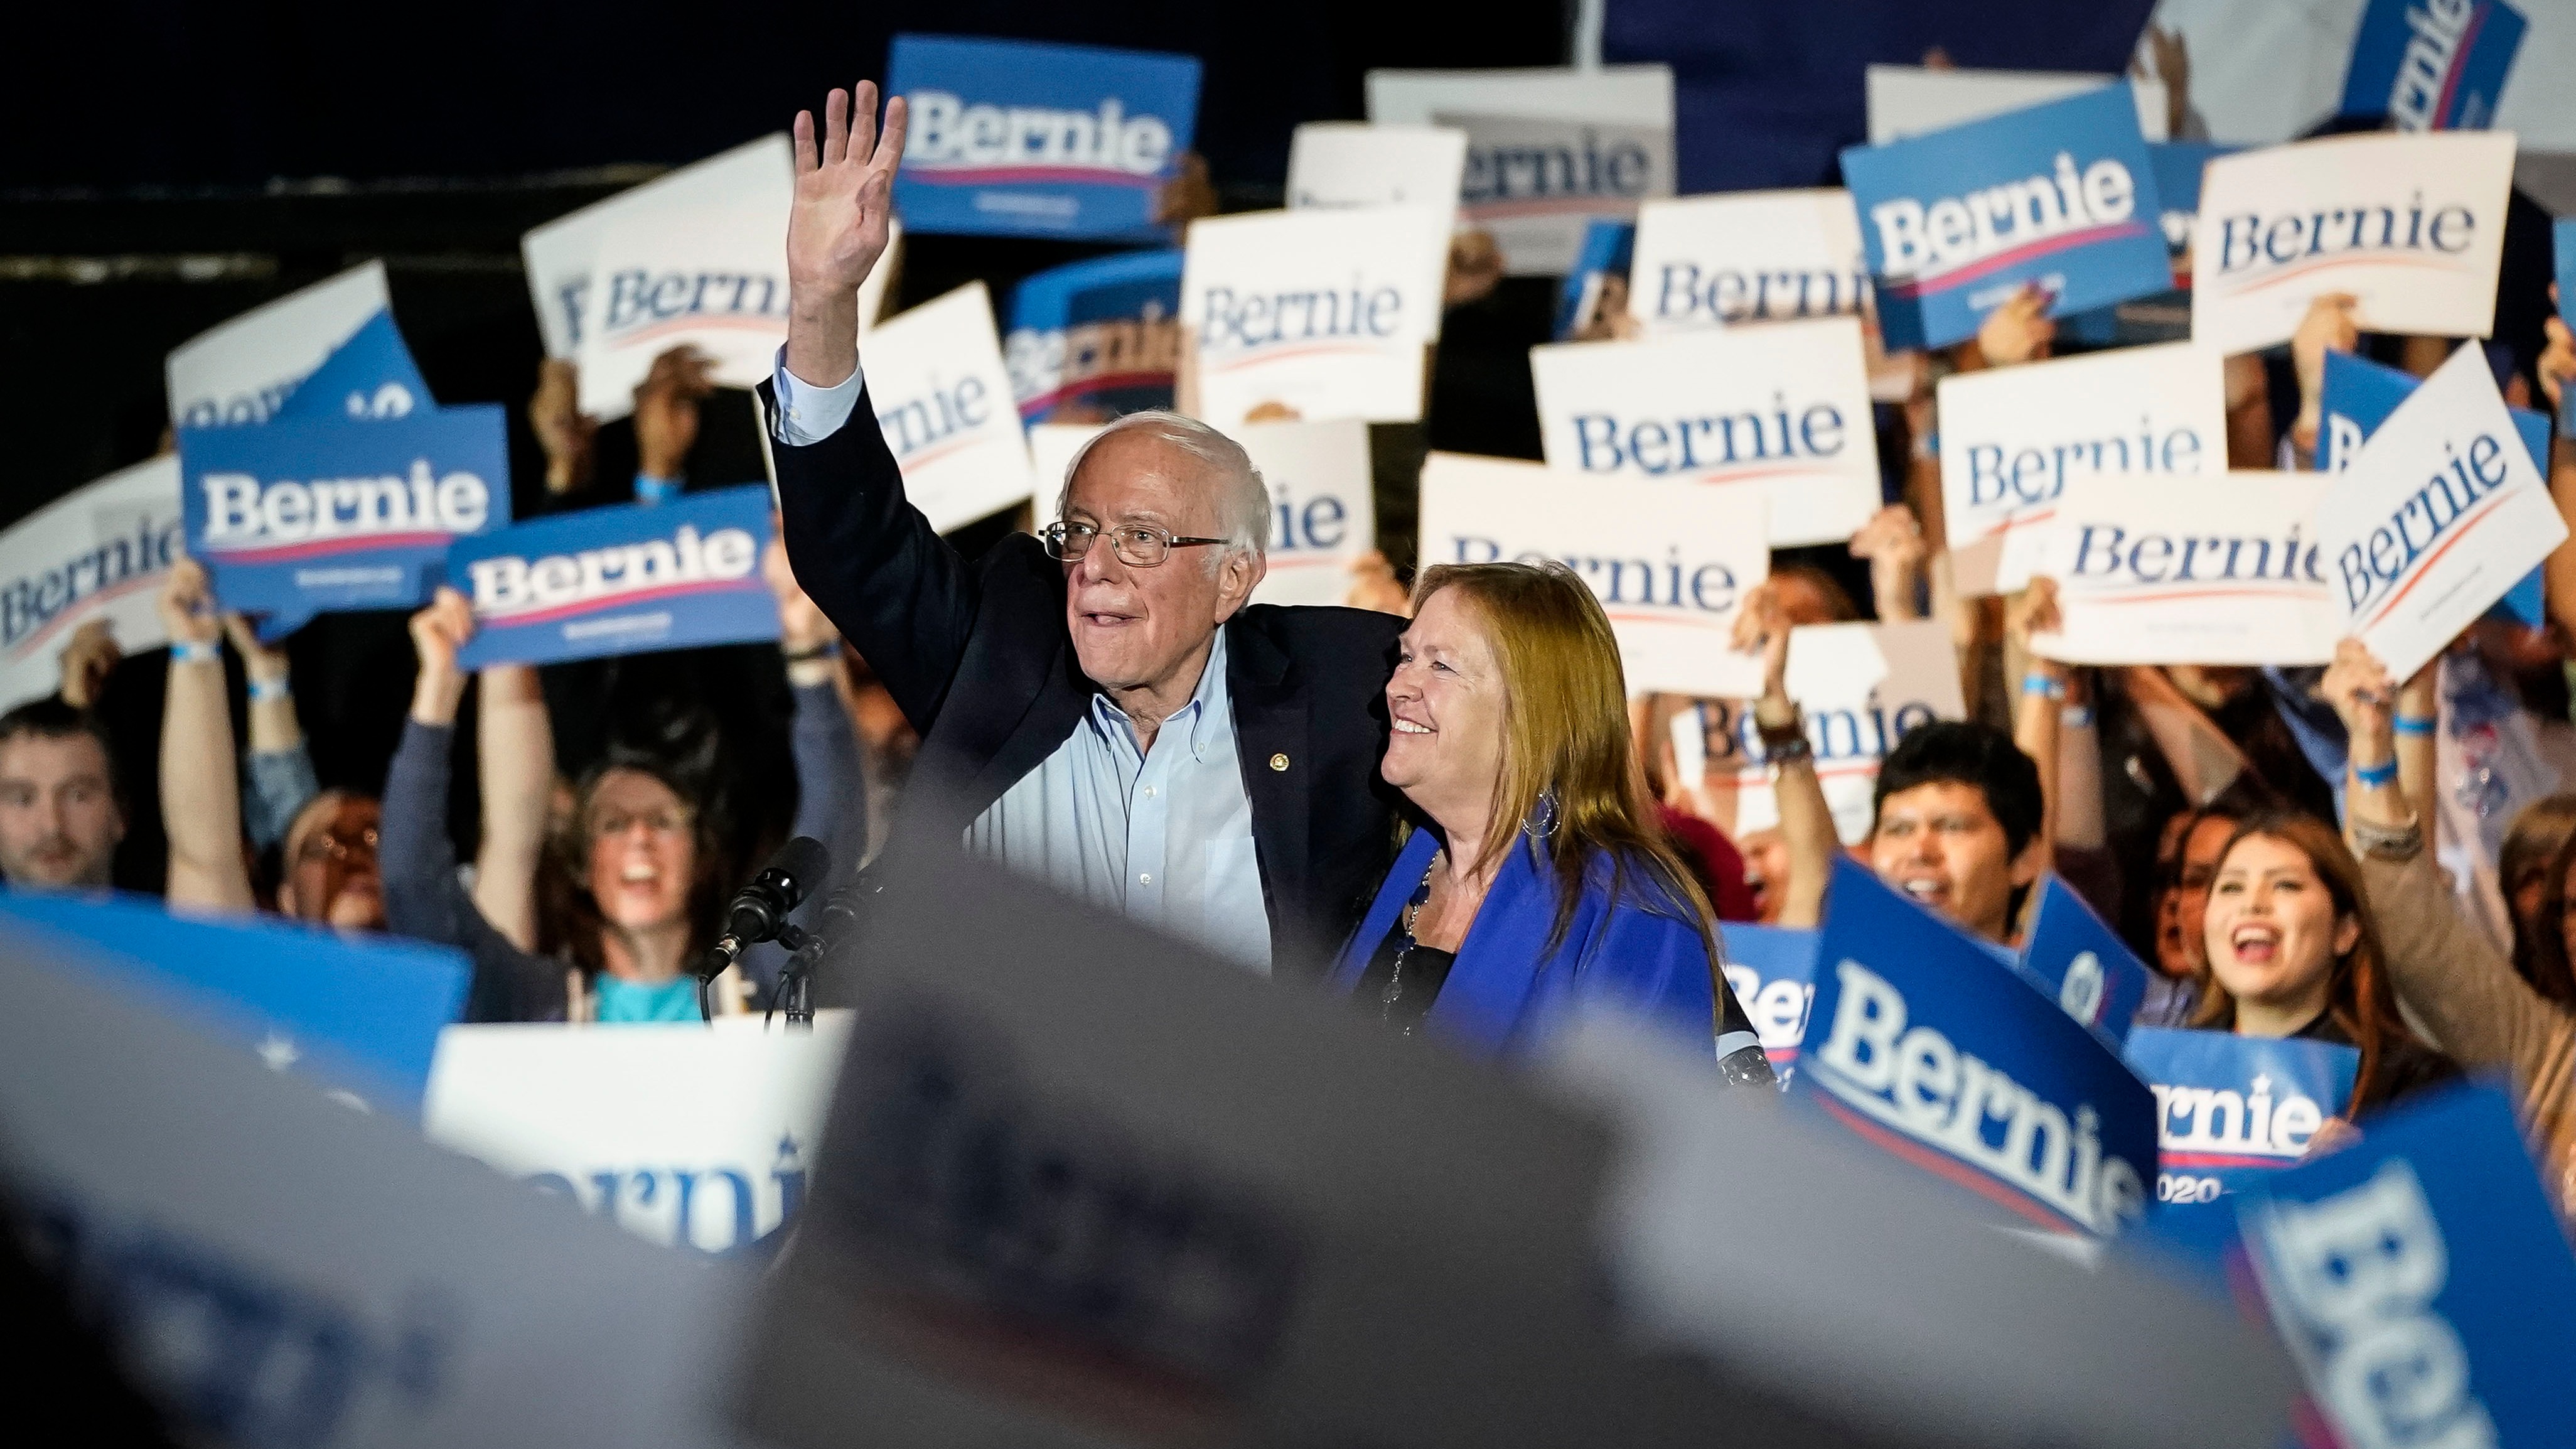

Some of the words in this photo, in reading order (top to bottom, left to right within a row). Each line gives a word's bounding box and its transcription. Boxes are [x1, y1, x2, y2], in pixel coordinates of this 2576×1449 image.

[907, 90, 1173, 174] Bernie
[1872, 151, 2134, 276] Bernie
[2217, 190, 2476, 276] Bernie
[604, 268, 785, 330] Bern
[1199, 269, 1402, 348] Bernie
[1570, 388, 1845, 476] Bernie
[1967, 413, 2202, 506] Bernie
[202, 460, 489, 541] Bernie
[2339, 433, 2507, 610] Bernie
[471, 525, 756, 612] Bernie
[1817, 957, 2145, 1237] Bernie
